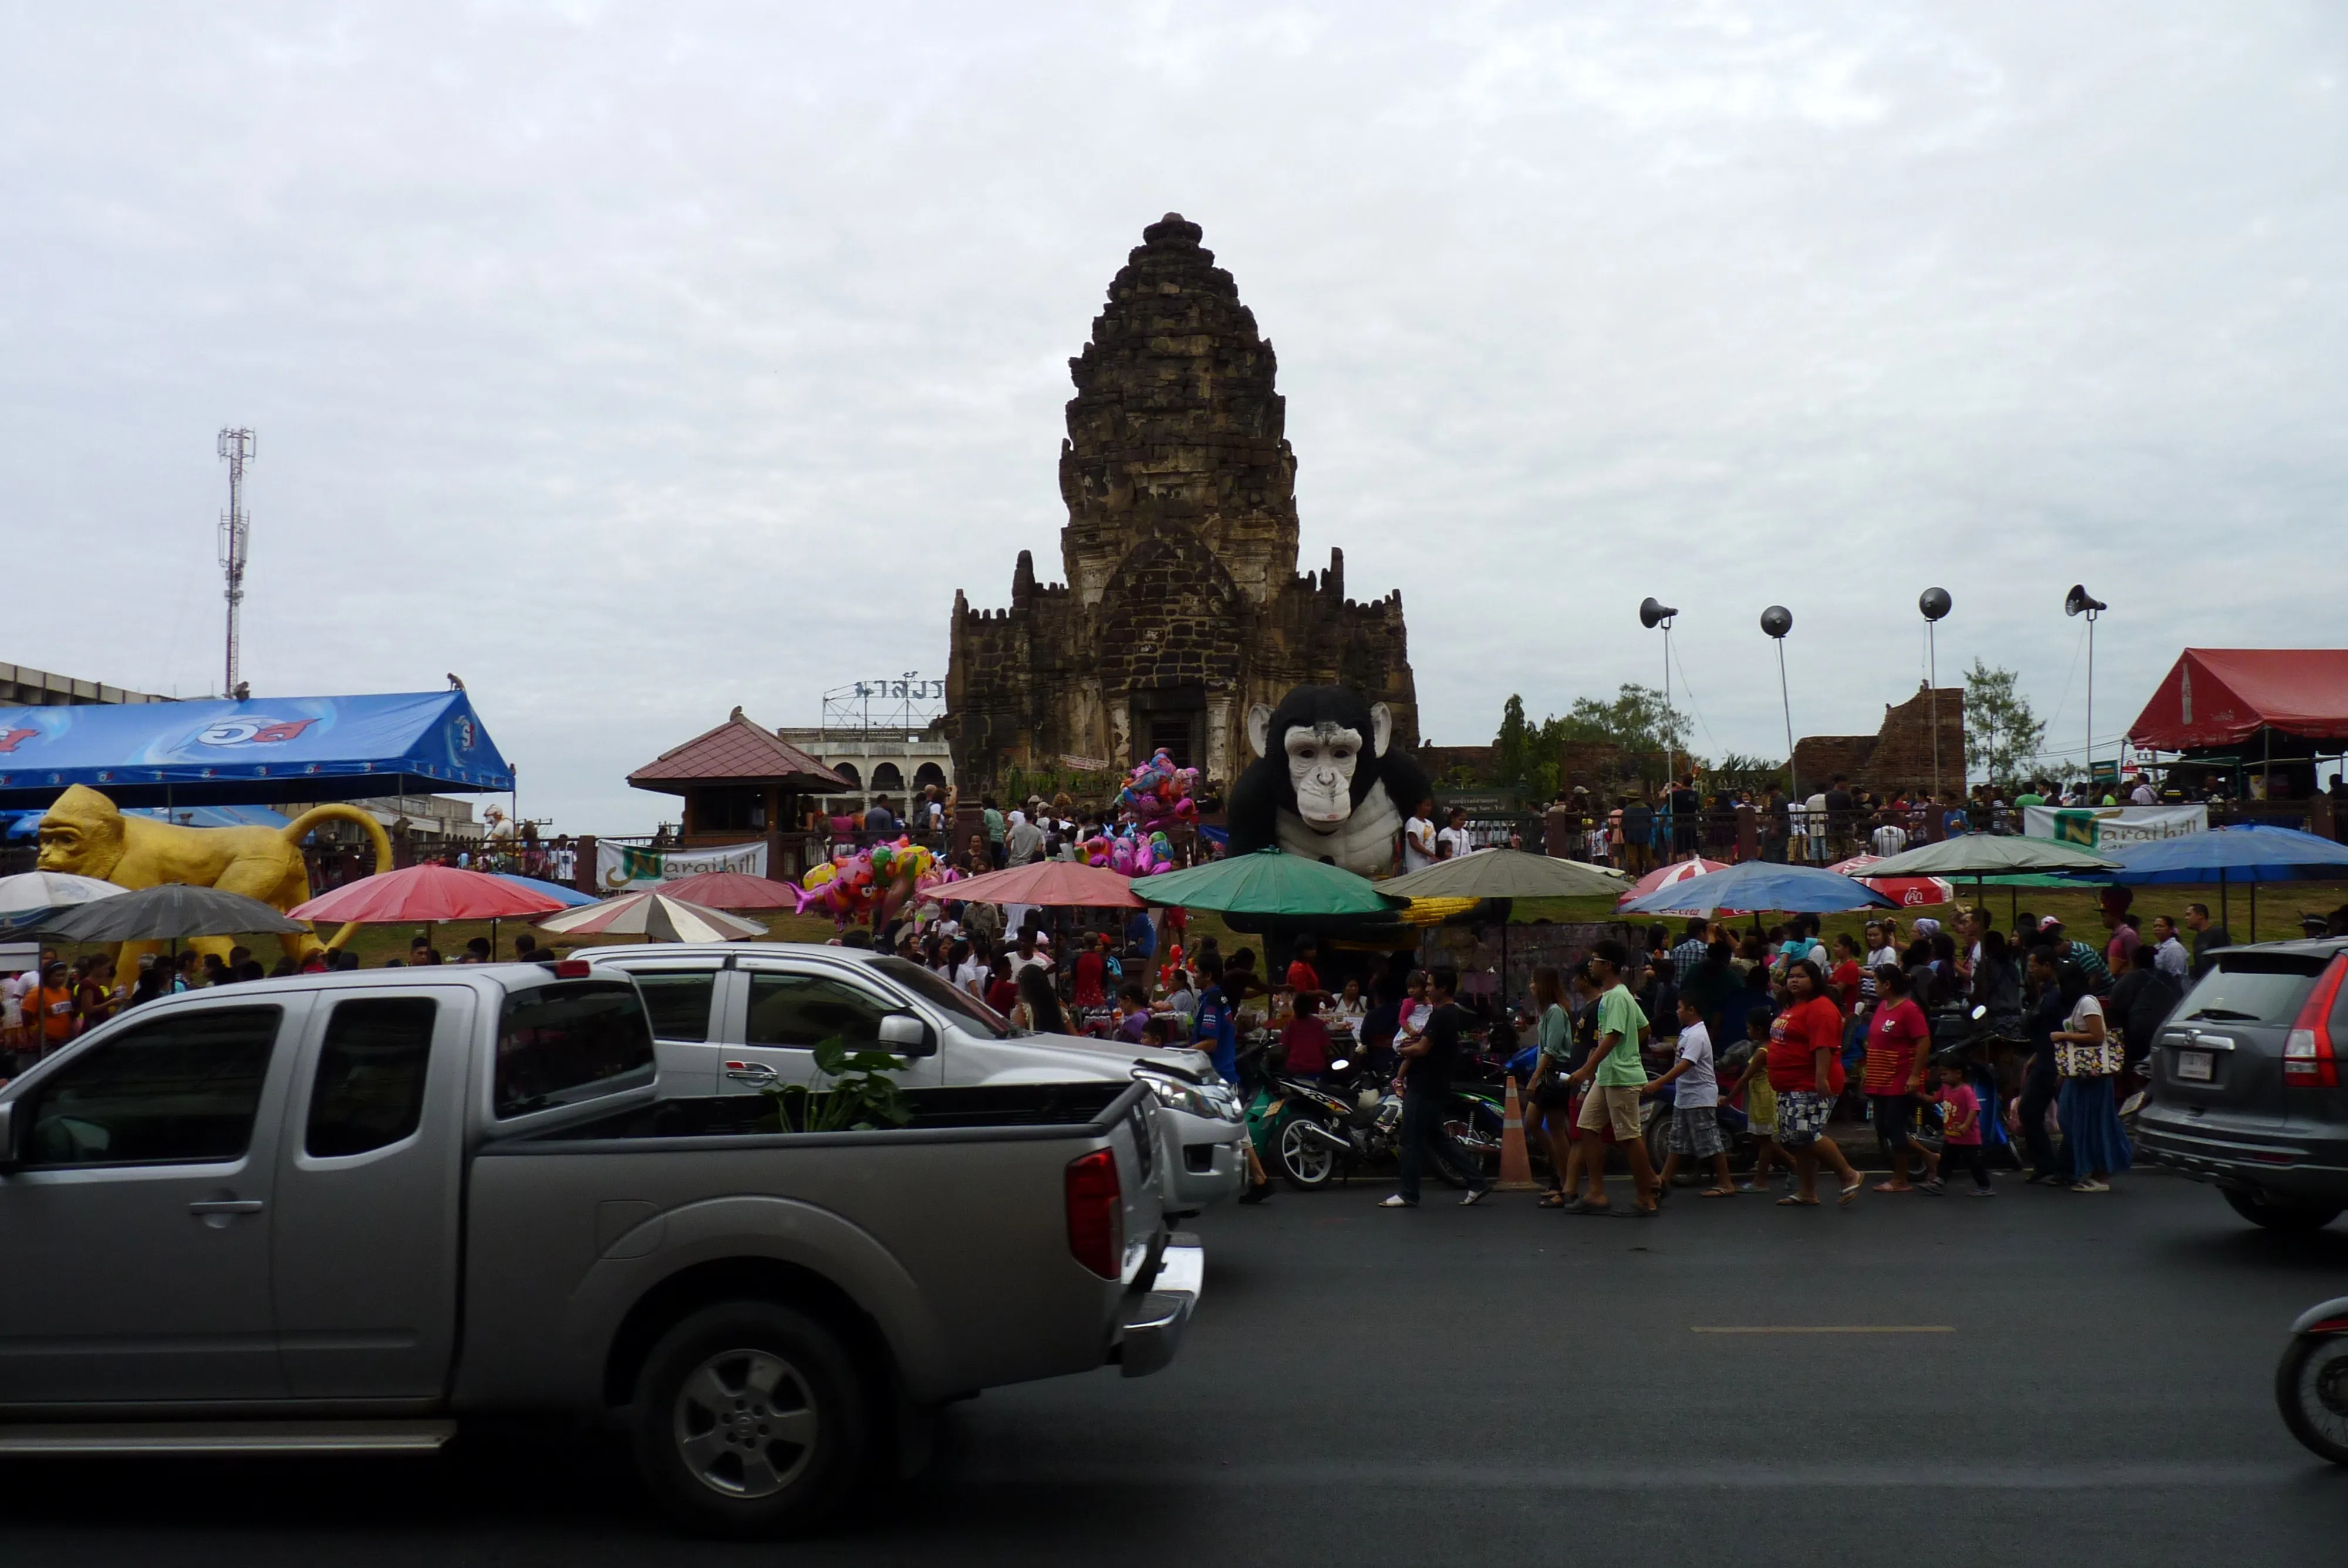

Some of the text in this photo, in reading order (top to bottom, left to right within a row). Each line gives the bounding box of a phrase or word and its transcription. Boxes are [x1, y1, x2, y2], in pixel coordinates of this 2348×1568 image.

[2062, 808, 2197, 846] Narai hill
[605, 849, 757, 888] Narai hill
